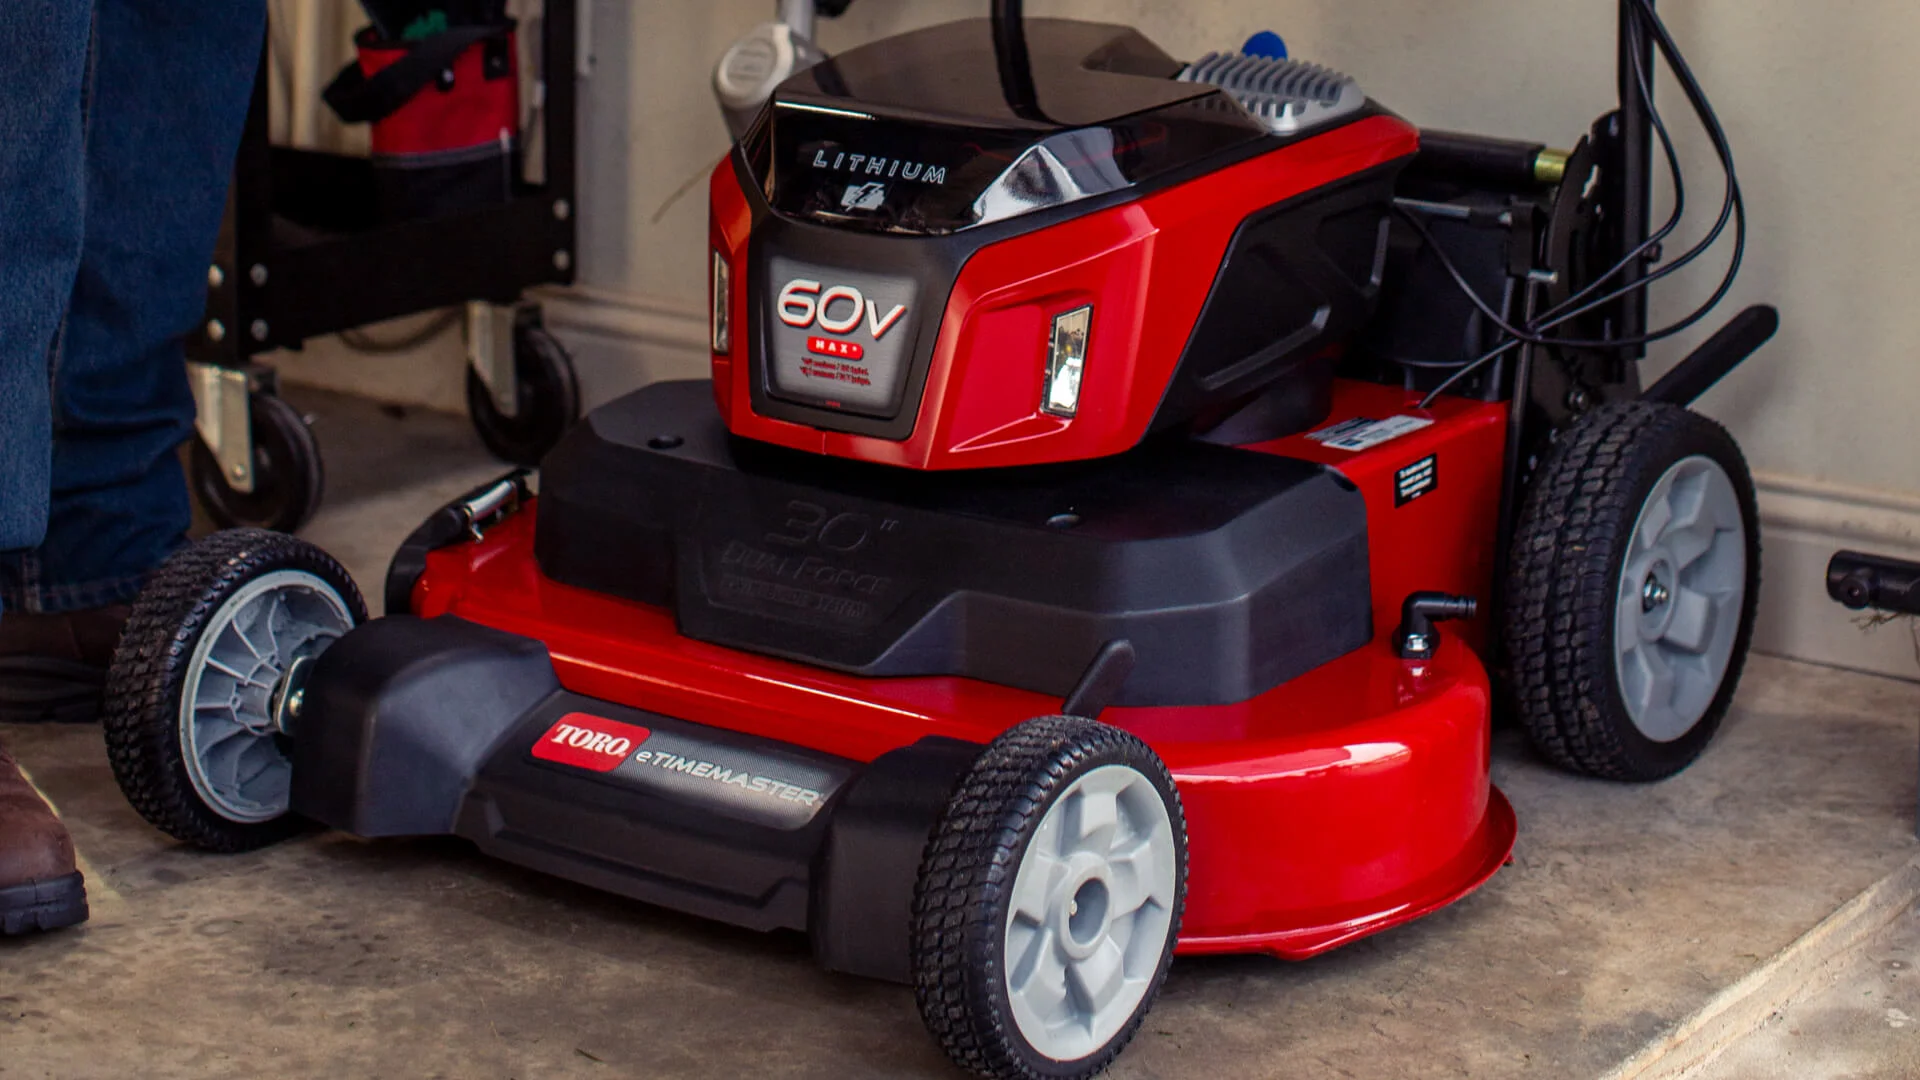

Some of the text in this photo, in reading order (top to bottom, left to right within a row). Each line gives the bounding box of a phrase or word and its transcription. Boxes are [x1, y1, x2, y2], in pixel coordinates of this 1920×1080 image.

[813, 150, 946, 184] LITHIUM
[551, 723, 631, 756] TORO
[635, 750, 819, 806] eTIMEMASTER
